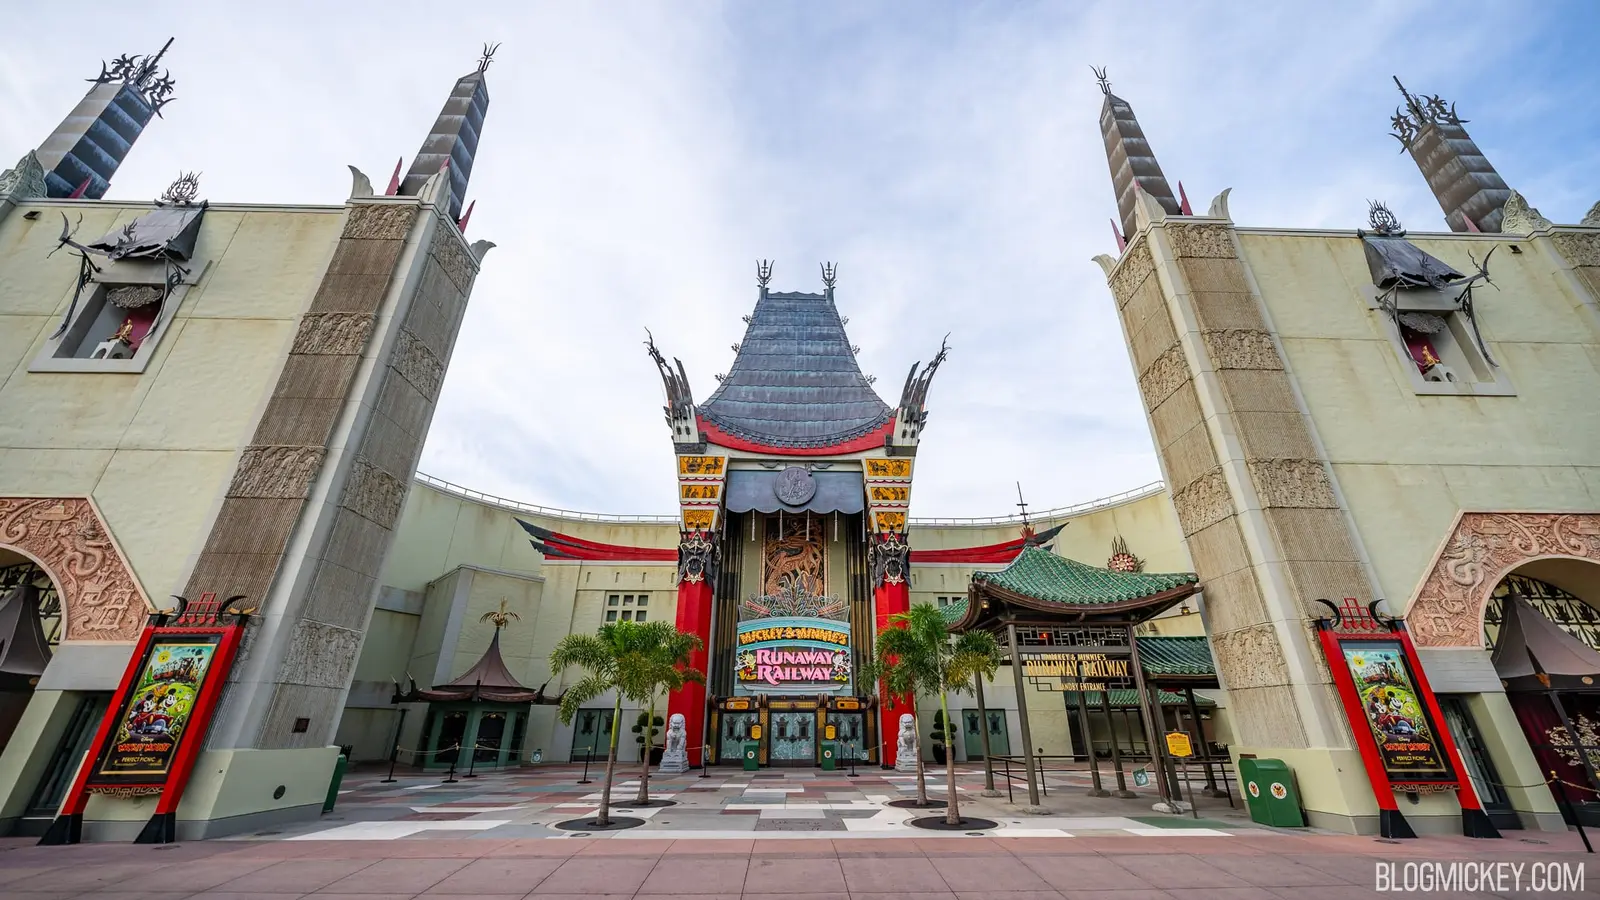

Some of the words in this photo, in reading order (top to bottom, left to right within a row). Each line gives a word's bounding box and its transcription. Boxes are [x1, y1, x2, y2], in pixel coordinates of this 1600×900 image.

[740, 627, 784, 645] MICKEY
[785, 627, 796, 639] &
[756, 650, 834, 665] RUNAWAY
[757, 665, 833, 685] RAILWAY
[1026, 660, 1078, 677] RUNAWAY
[1082, 660, 1128, 677] RAILWAY
[1080, 683, 1106, 691] ENTRANCE
